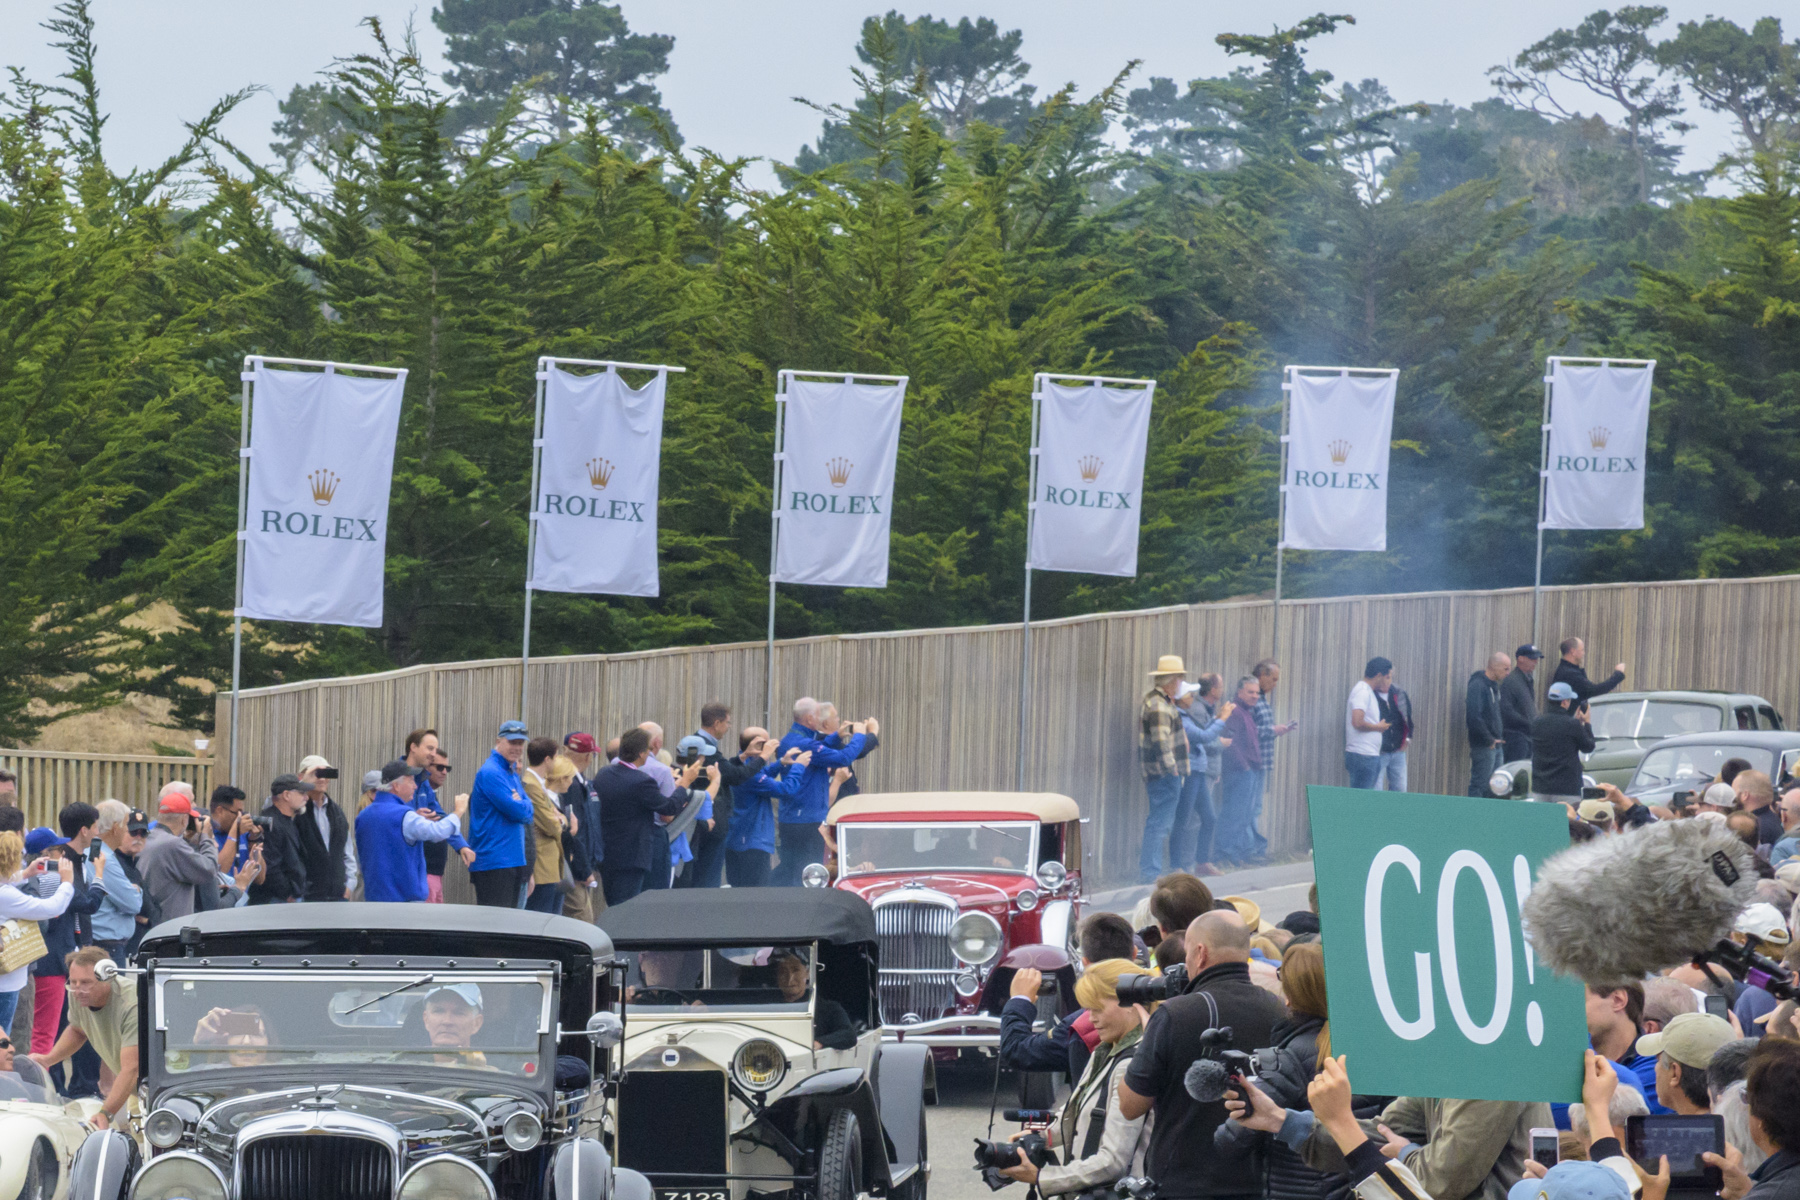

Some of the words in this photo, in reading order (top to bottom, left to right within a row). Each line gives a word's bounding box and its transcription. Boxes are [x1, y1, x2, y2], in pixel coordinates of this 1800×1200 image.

[1556, 455, 1637, 472] ROLEX
[1295, 470, 1380, 490] ROLEX
[544, 494, 645, 523] ROLEX
[790, 491, 882, 514] ROLEX
[1044, 485, 1131, 509] ROLEX
[260, 510, 377, 542] ROLEX
[1364, 844, 1545, 1047] GO!
